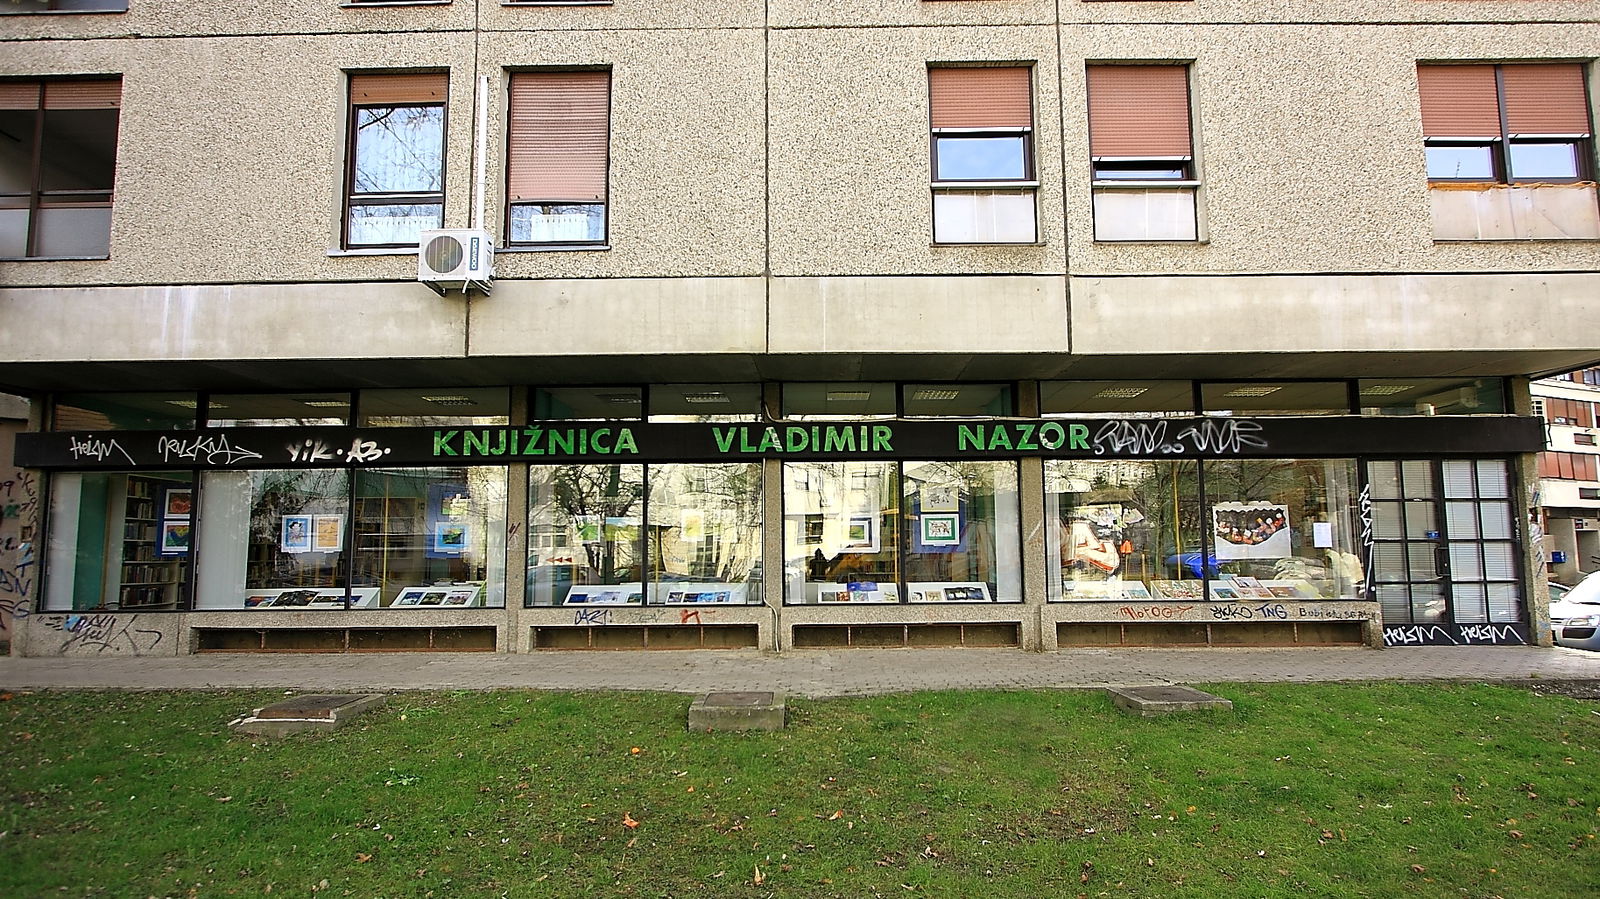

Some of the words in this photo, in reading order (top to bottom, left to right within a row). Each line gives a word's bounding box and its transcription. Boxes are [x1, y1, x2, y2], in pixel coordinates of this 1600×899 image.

[433, 425, 640, 456] KNJIŽNICA
[712, 425, 894, 453] VLADIMIR
[958, 421, 1091, 450] NAZOR
